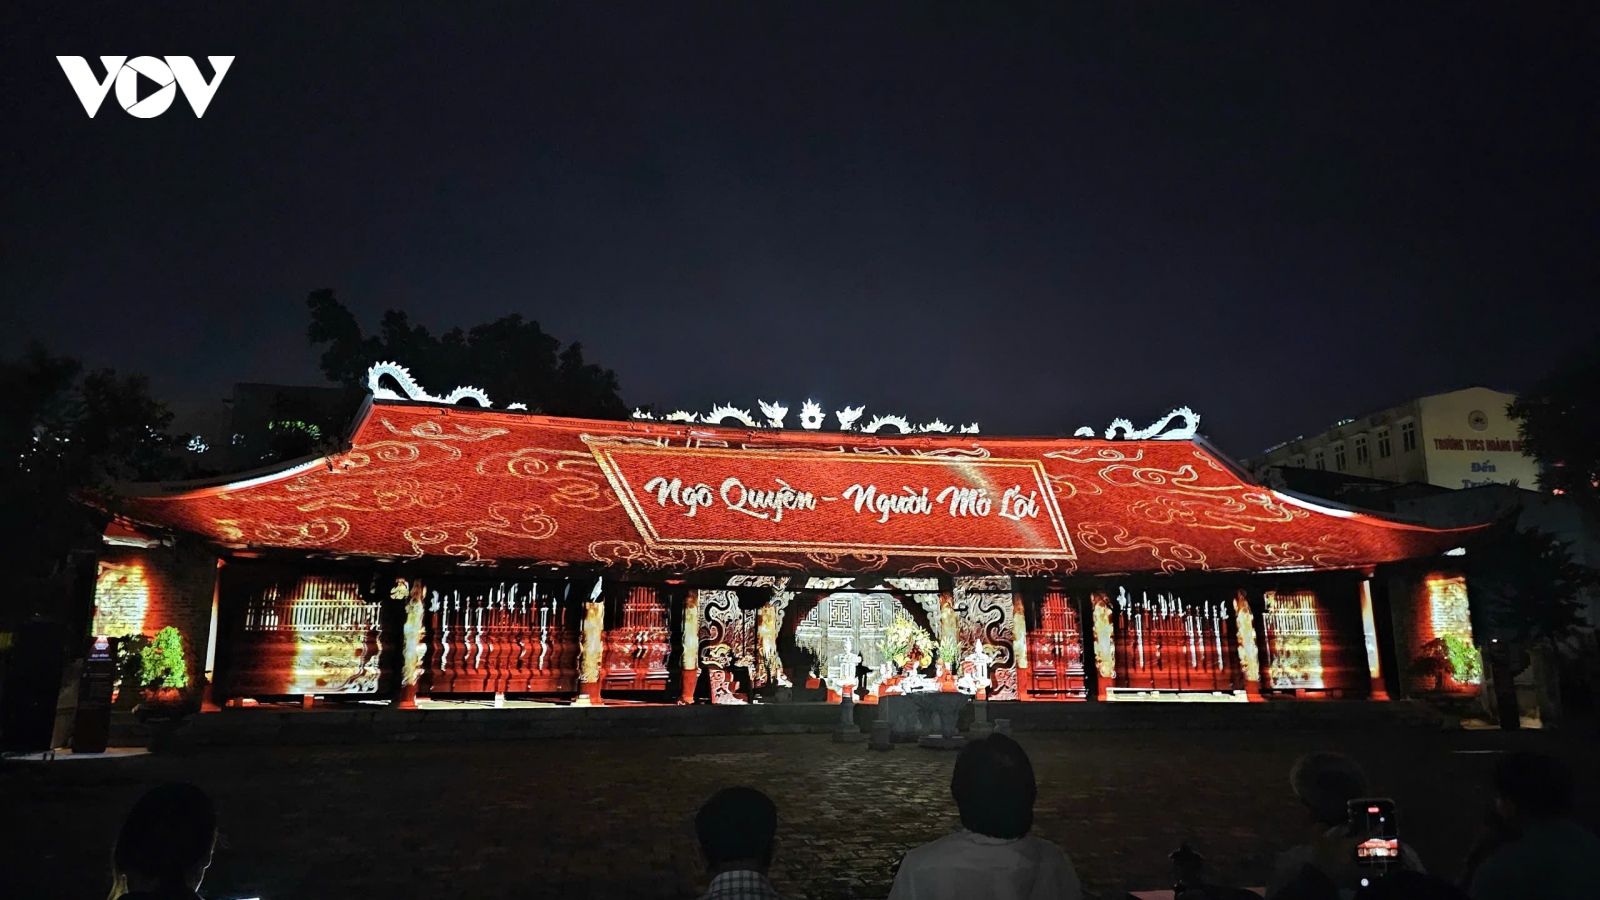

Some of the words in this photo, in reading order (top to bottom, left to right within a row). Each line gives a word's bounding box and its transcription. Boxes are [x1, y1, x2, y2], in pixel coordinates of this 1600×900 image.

[1465, 439, 1485, 452] THCS
[1486, 437, 1512, 452] HOÀNG
[1471, 460, 1496, 473] Đến
[643, 476, 714, 517] Ngô
[720, 477, 817, 523] Quyền
[841, 483, 933, 524] Người
[936, 485, 992, 518] Mở
[998, 484, 1040, 521] Lối
